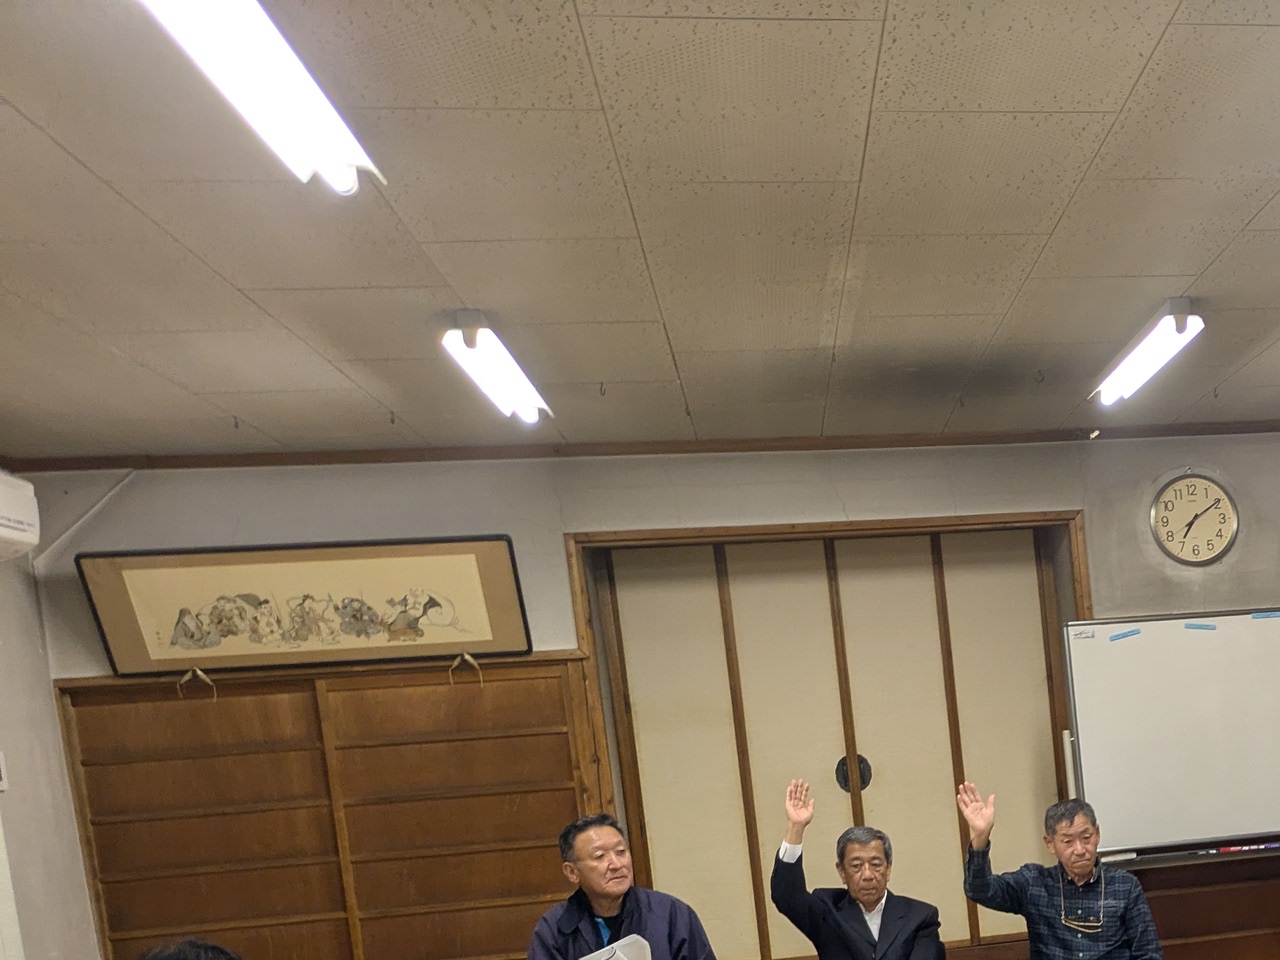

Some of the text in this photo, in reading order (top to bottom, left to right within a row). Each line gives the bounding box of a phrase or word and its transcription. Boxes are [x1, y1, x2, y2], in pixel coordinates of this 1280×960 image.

[1173, 488, 1183, 500] 11
[1186, 484, 1197, 496] 12
[1203, 488, 1209, 499] 1
[1163, 500, 1175, 511] 10
[1213, 498, 1221, 509] 2
[1161, 516, 1169, 527] 9
[1218, 513, 1226, 524] 3
[1166, 531, 1174, 542] 8
[1216, 529, 1223, 539] 4
[1178, 541, 1185, 553] 7
[1192, 545, 1200, 556] 6
[1207, 540, 1214, 550] 5
